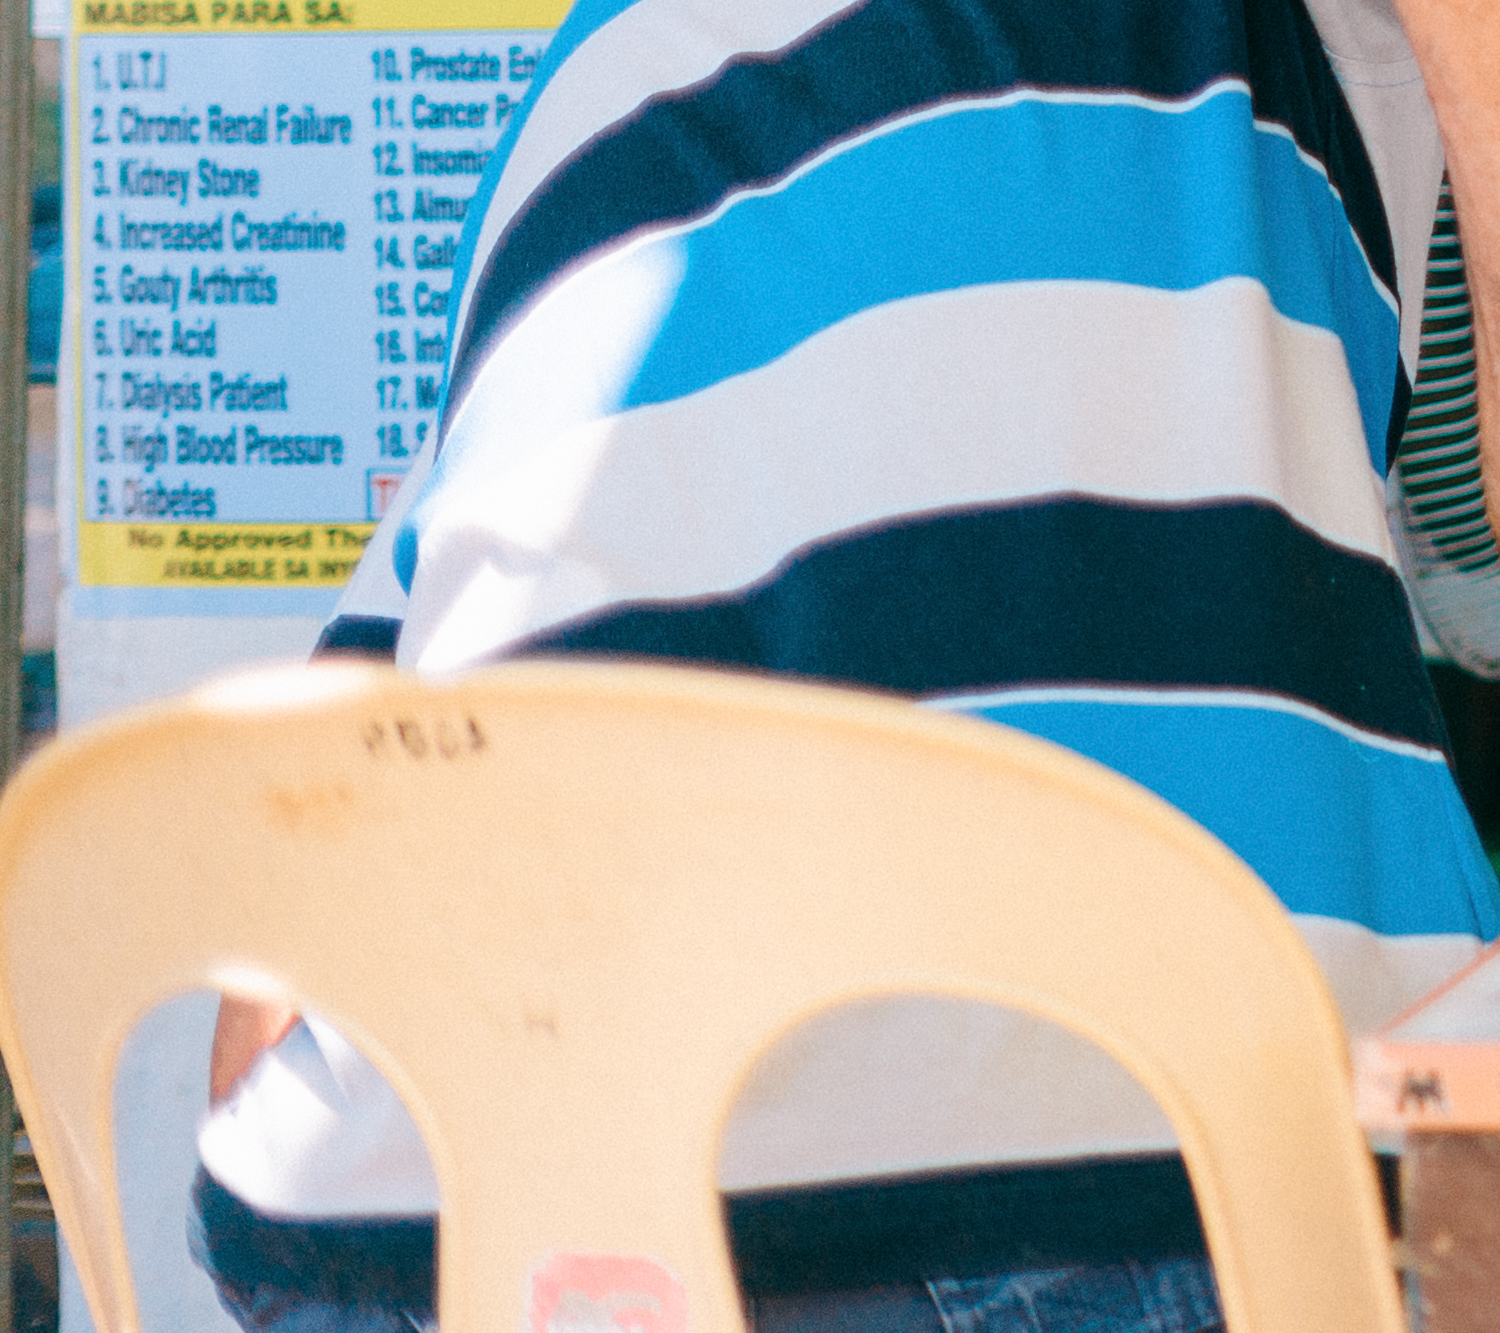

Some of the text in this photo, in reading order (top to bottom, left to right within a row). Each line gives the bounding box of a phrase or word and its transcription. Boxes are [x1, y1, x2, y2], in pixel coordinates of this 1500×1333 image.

[211, 0, 292, 25] PARA
[411, 47, 499, 81] Prostate
[119, 106, 200, 144] Chronic
[276, 104, 352, 144] Failure
[412, 94, 489, 128] Cancer
[118, 159, 190, 205] Kidney
[199, 158, 259, 197] Stone
[119, 211, 223, 251] Increased
[232, 210, 346, 251] Creatinine
[119, 264, 180, 312] Gouty
[122, 371, 202, 419] Dialysis
[210, 371, 288, 411] Patient
[376, 376, 408, 410] 17.
[177, 425, 236, 465] Blood
[245, 425, 344, 465] Pressure
[176, 528, 313, 551] Approved
